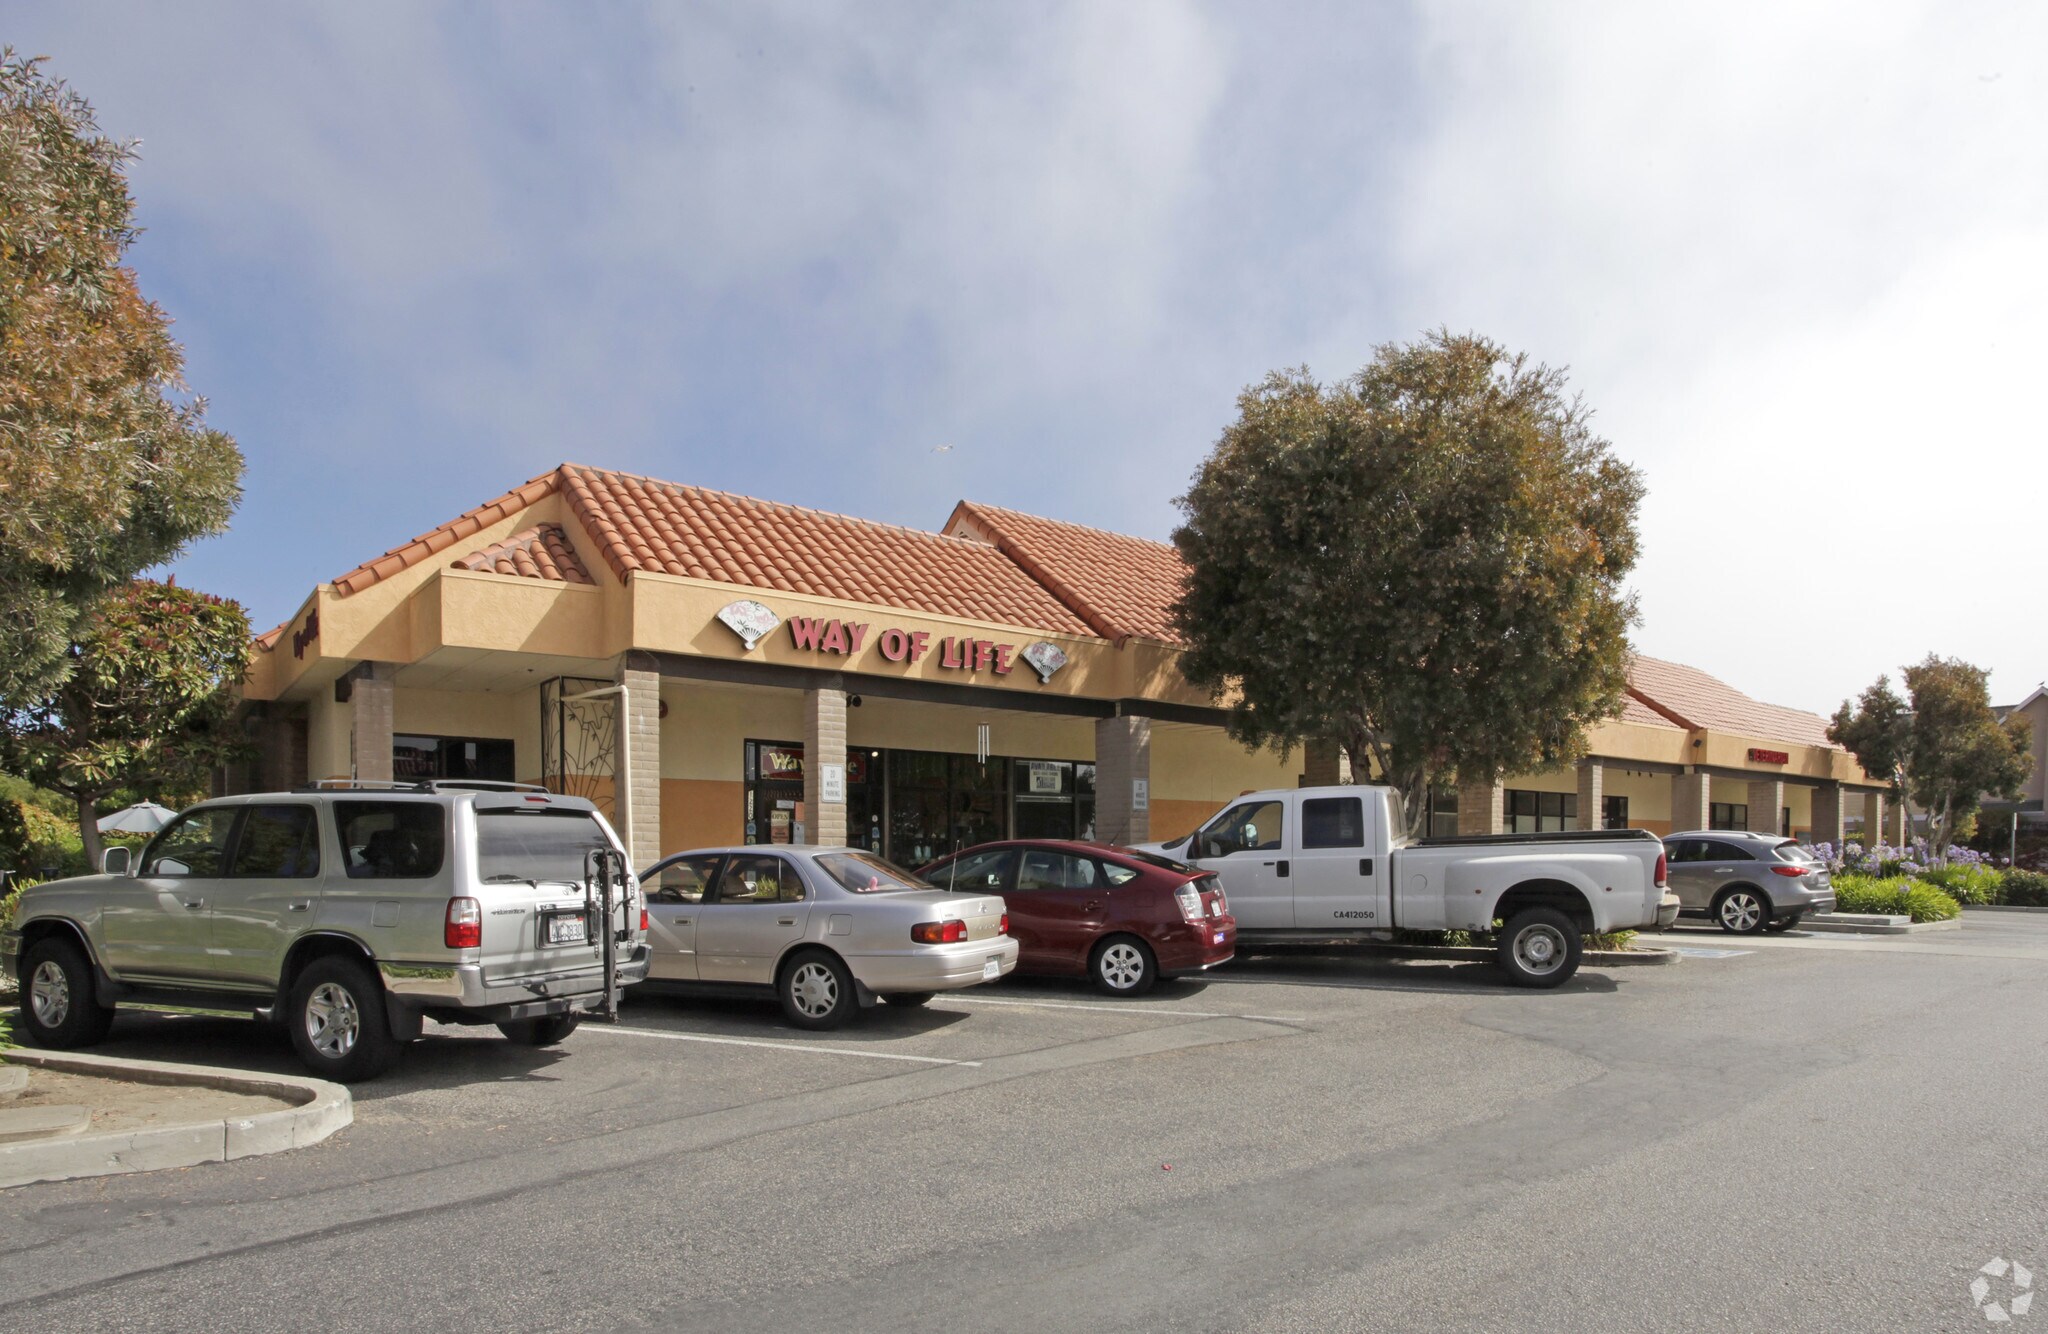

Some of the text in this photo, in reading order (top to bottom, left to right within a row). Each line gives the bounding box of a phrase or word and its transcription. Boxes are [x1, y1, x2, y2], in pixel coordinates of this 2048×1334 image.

[786, 615, 1015, 676] WAY OF LIFE
[1333, 910, 1375, 919] CA412050
